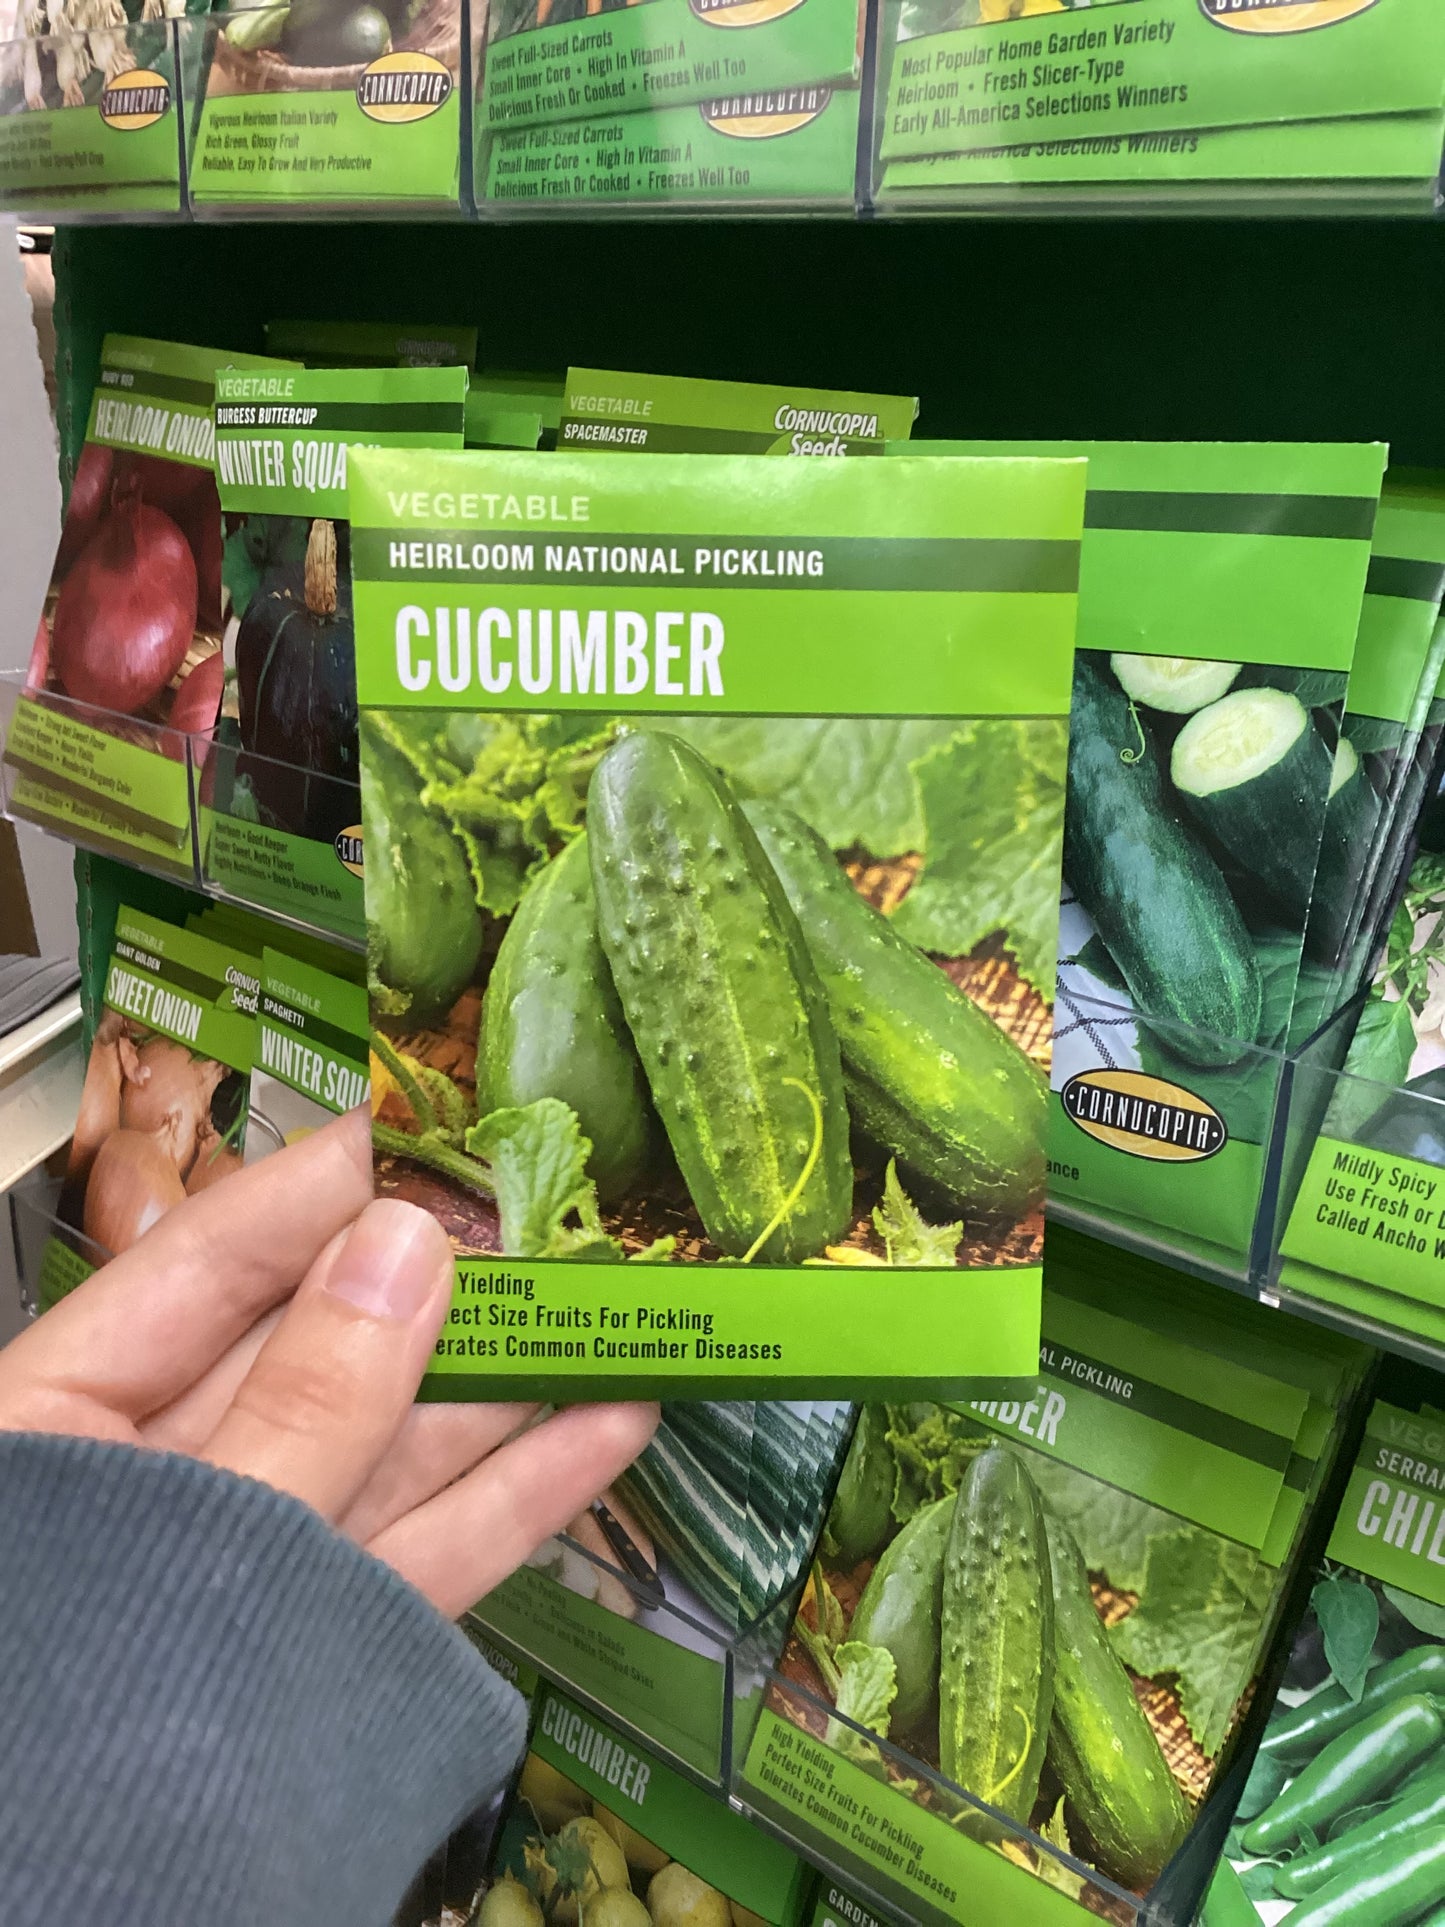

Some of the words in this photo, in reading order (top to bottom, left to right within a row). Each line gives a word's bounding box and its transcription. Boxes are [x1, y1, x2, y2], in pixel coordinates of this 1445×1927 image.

[517, 39, 569, 67] Full-Sized
[572, 30, 613, 54] Carrots
[901, 54, 931, 78] Most
[935, 43, 993, 73] Popular
[998, 37, 1043, 62] Home
[1047, 29, 1108, 56] Garden
[1112, 19, 1176, 49] Variety
[489, 72, 514, 97] Small
[515, 70, 543, 93] Inner
[545, 65, 572, 86] Core
[587, 54, 613, 77] High
[615, 53, 628, 71] In
[630, 42, 675, 68] Vitamin
[677, 39, 687, 58] A
[896, 80, 960, 108] Heirloom
[983, 69, 1029, 93] Fresh
[1032, 57, 1126, 87] Slicer-Type
[106, 87, 165, 115] CORNUCOPIA
[363, 74, 441, 105] CORNUCOPIA
[488, 97, 534, 122] Delicious
[535, 91, 566, 115] Fresh
[567, 88, 582, 107] Or
[583, 80, 626, 105] Cooked
[642, 67, 690, 93] Freezes
[692, 60, 720, 83] Well
[722, 57, 747, 79] Too
[893, 111, 929, 136] Early
[931, 97, 1021, 130] All-America
[1025, 87, 1112, 117] Selections
[1116, 82, 1189, 107] Winners
[499, 129, 527, 152] Sweet
[528, 130, 580, 149] Full-Sized
[583, 124, 623, 144] Carrots
[1127, 135, 1199, 154] Winners
[327, 154, 372, 171] Productive
[496, 156, 522, 175] Small
[524, 156, 551, 173] Inner
[554, 155, 579, 170] Core
[596, 148, 621, 170] High
[623, 148, 635, 165] In
[638, 144, 682, 164] Vitamin
[684, 142, 693, 161] A
[494, 179, 539, 199] Delicious
[541, 176, 571, 195] Fresh
[573, 175, 586, 193] Or
[588, 171, 630, 192] Cooked
[648, 171, 694, 190] Freezes
[698, 169, 725, 187] Well
[728, 168, 750, 185] Too
[218, 377, 294, 398] VEGETABLE
[95, 399, 170, 449] HEIRLOOM
[217, 407, 256, 425] BURGESS
[257, 407, 318, 425] BUTTERCUP
[569, 396, 653, 417] VEGETABLE
[774, 404, 879, 438] CORNUCOPIA
[564, 423, 648, 446] SPACEMASTER
[788, 434, 849, 457] Seeds
[217, 439, 287, 487] WINTER
[292, 440, 381, 494] SQUA
[387, 491, 590, 522] VEGETABLE
[389, 542, 535, 572] HEIRLOOM
[545, 546, 685, 575] NATIONAL
[695, 549, 825, 577] PICKLING
[395, 605, 726, 697] CUCUMBER
[120, 926, 165, 951] VEGETABLE
[116, 942, 134, 961] GIANT
[135, 952, 161, 972] GOLDEN
[225, 965, 260, 995] CORNUC
[267, 975, 322, 1013] VEGETABLE
[107, 966, 154, 1019] SWEET
[151, 988, 203, 1042] ONION
[264, 998, 305, 1029] SPAGHETTI
[261, 1025, 323, 1095] WINTER
[324, 1060, 371, 1111] SQU
[1076, 1085, 1210, 1149] CORNUCOPIA
[1333, 1151, 1384, 1185] Mildly
[1388, 1167, 1438, 1201] Spicy
[1325, 1177, 1356, 1203] Use
[1360, 1188, 1410, 1219] Fresh
[1414, 1207, 1435, 1225] or
[1316, 1203, 1370, 1236] Called
[1373, 1220, 1427, 1254] Ancho
[458, 1272, 536, 1300] Yielding
[488, 1303, 528, 1327] Size
[536, 1306, 593, 1329] Fruits
[600, 1307, 630, 1330] For
[636, 1308, 715, 1334] Pickling
[435, 1336, 498, 1357] erates
[505, 1335, 586, 1359] Common
[593, 1337, 690, 1359] Cucumber
[695, 1338, 783, 1361] Diseases
[1060, 1356, 1134, 1399] PICKLING
[541, 1696, 650, 1806] CUCUMBER
[770, 1723, 793, 1749] High
[796, 1738, 836, 1780] Yielding
[765, 1743, 802, 1780] Perfect
[804, 1767, 826, 1793] Size
[828, 1782, 859, 1815] Fruits
[860, 1805, 878, 1828] For
[880, 1815, 925, 1861] Pickling
[759, 1761, 804, 1804] Tolerates
[806, 1795, 850, 1834] Common
[850, 1825, 905, 1869] Cucumber
[905, 1858, 958, 1904] Diseases
